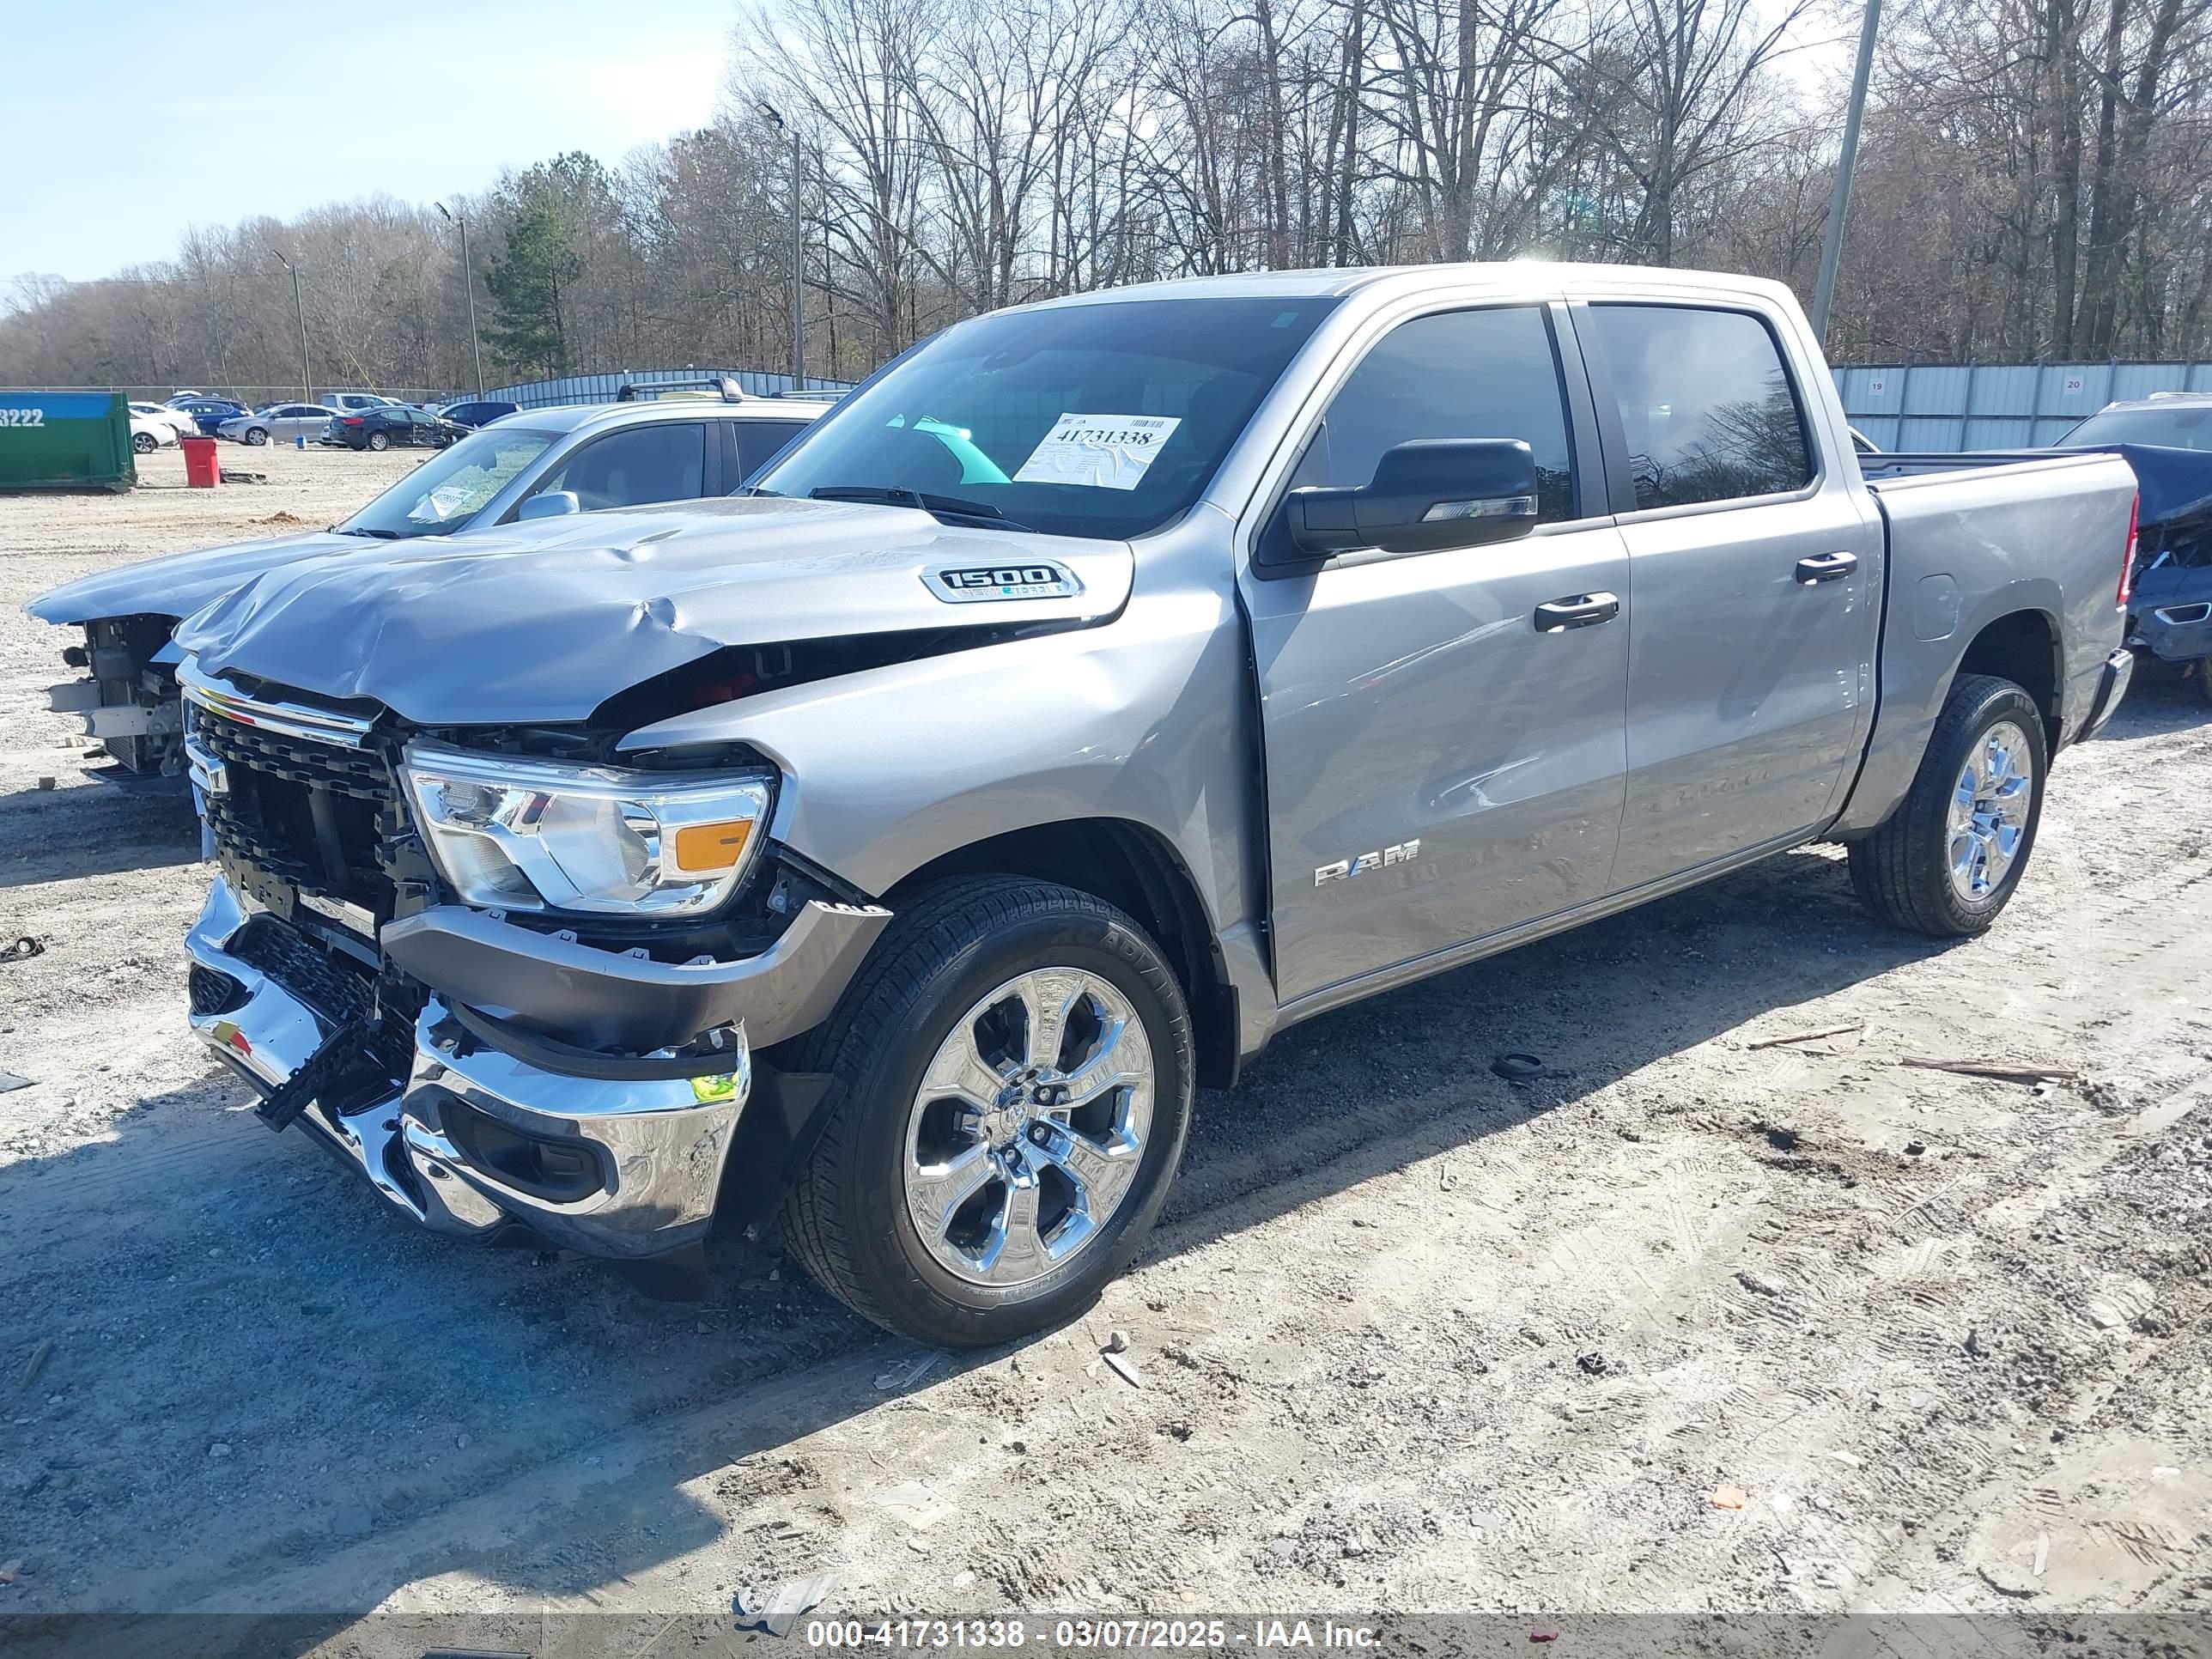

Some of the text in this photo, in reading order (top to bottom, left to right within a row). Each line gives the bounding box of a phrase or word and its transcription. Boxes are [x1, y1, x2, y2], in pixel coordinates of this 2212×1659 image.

[2067, 380, 2081, 389] 20
[0, 408, 45, 427] 3222
[1055, 428, 1154, 446] 41731338
[945, 568, 1052, 587] 1500
[1313, 837, 1421, 888] RAM
